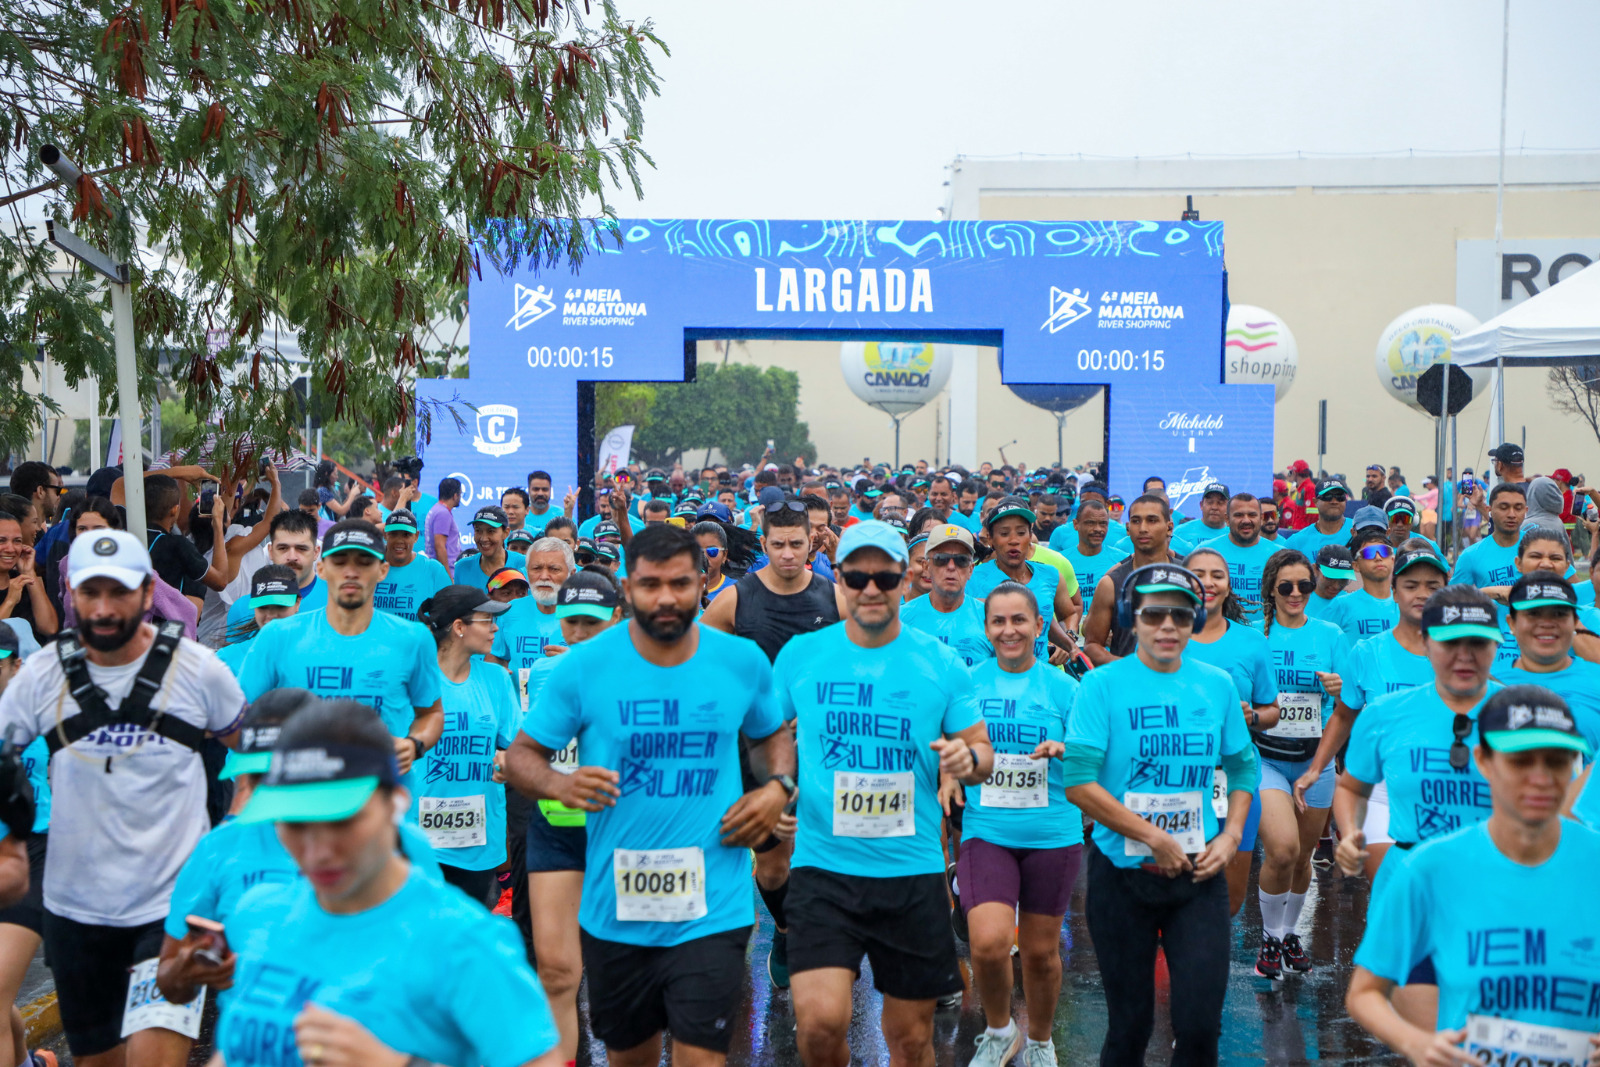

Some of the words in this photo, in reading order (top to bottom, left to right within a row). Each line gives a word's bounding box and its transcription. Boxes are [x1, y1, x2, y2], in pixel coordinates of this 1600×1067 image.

[584, 289, 622, 302] MEIA
[755, 267, 933, 312] LARGADA
[1120, 292, 1159, 305] MEIA
[562, 302, 647, 316] MARATONA
[1098, 305, 1184, 319] MARATONA
[562, 316, 591, 326] RIVER
[590, 316, 635, 326] SHOPPING
[1098, 319, 1124, 329] RIVER
[1125, 320, 1171, 329] SHOPPING
[1412, 317, 1461, 336] CRISTALINO
[527, 346, 614, 368] 00:00:15
[1077, 349, 1165, 371] 00:00:15
[1230, 356, 1297, 382] shopping
[1159, 411, 1224, 430] Michelob
[477, 486, 494, 500] JR
[1166, 476, 1219, 496] Gatorade
[1488, 564, 1515, 583] VEM
[1357, 618, 1391, 634] VEM
[516, 636, 550, 654] VEM
[306, 666, 353, 690] VEM
[816, 682, 874, 708] VEM
[617, 699, 680, 727] VEM
[1128, 705, 1180, 730] VEM
[826, 711, 912, 742] CORRER
[434, 735, 492, 757] CORRER
[630, 731, 719, 760] CORRER
[1139, 733, 1214, 758] CORRER
[646, 768, 720, 799] JUNTO!
[840, 792, 900, 813] 10114
[423, 811, 475, 829] 50453
[621, 870, 688, 894] 10081
[1467, 928, 1546, 967] VEM
